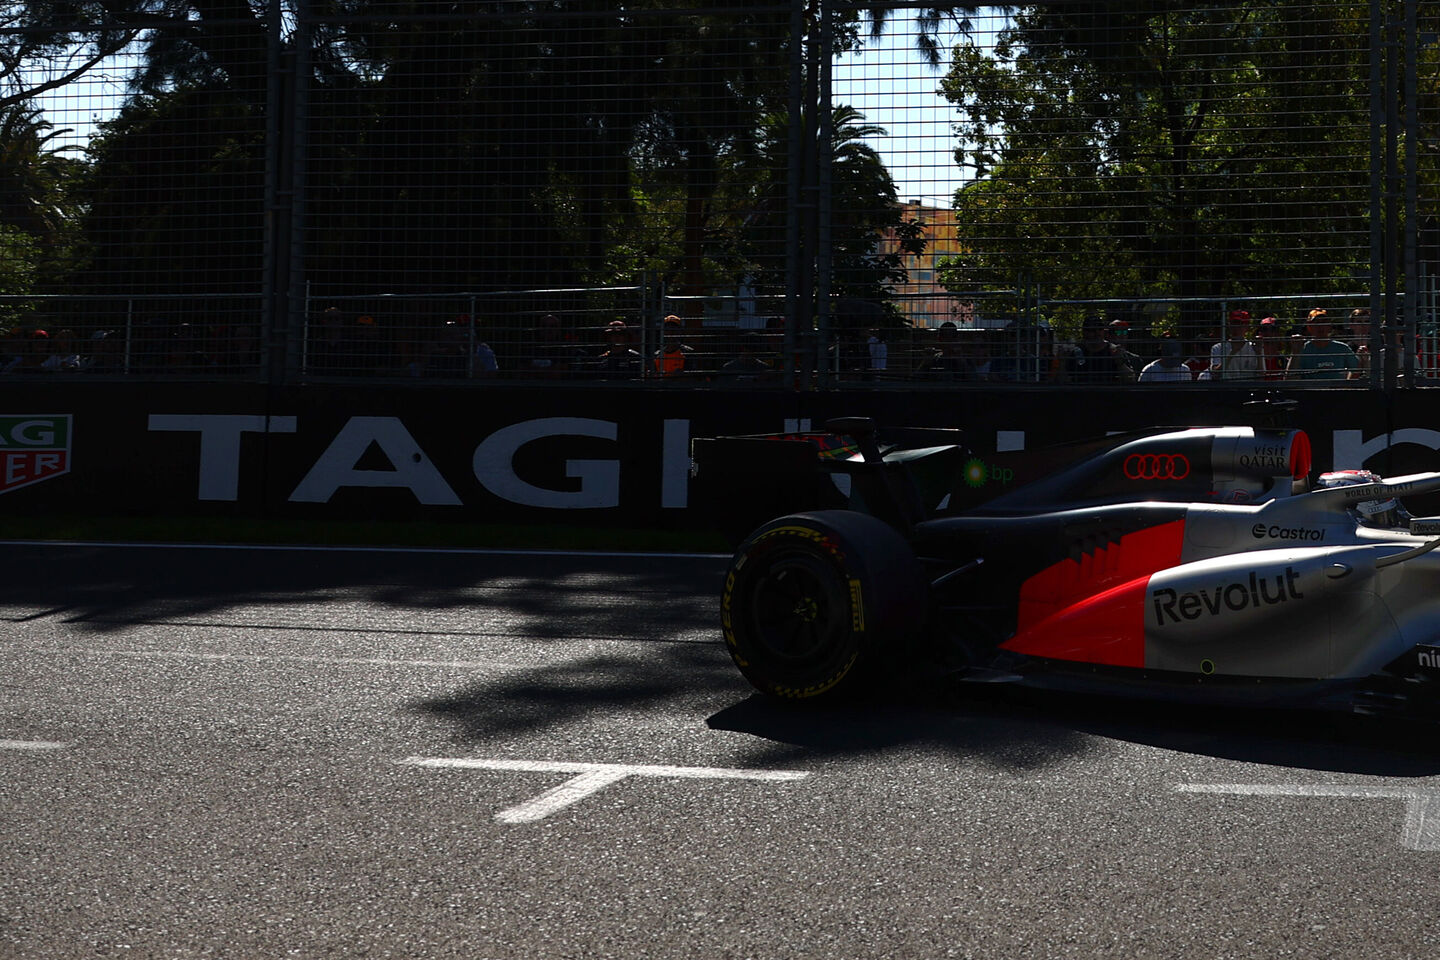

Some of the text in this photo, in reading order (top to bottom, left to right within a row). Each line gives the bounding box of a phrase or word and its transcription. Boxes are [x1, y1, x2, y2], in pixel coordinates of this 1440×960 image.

[1254, 444, 1287, 456] visit
[147, 413, 621, 509] TAG
[1239, 454, 1286, 469] QATAR
[991, 464, 1015, 485] bp
[1345, 488, 1371, 498] WORLD
[1268, 525, 1326, 541] Castrol
[1153, 566, 1304, 626] Revolut
